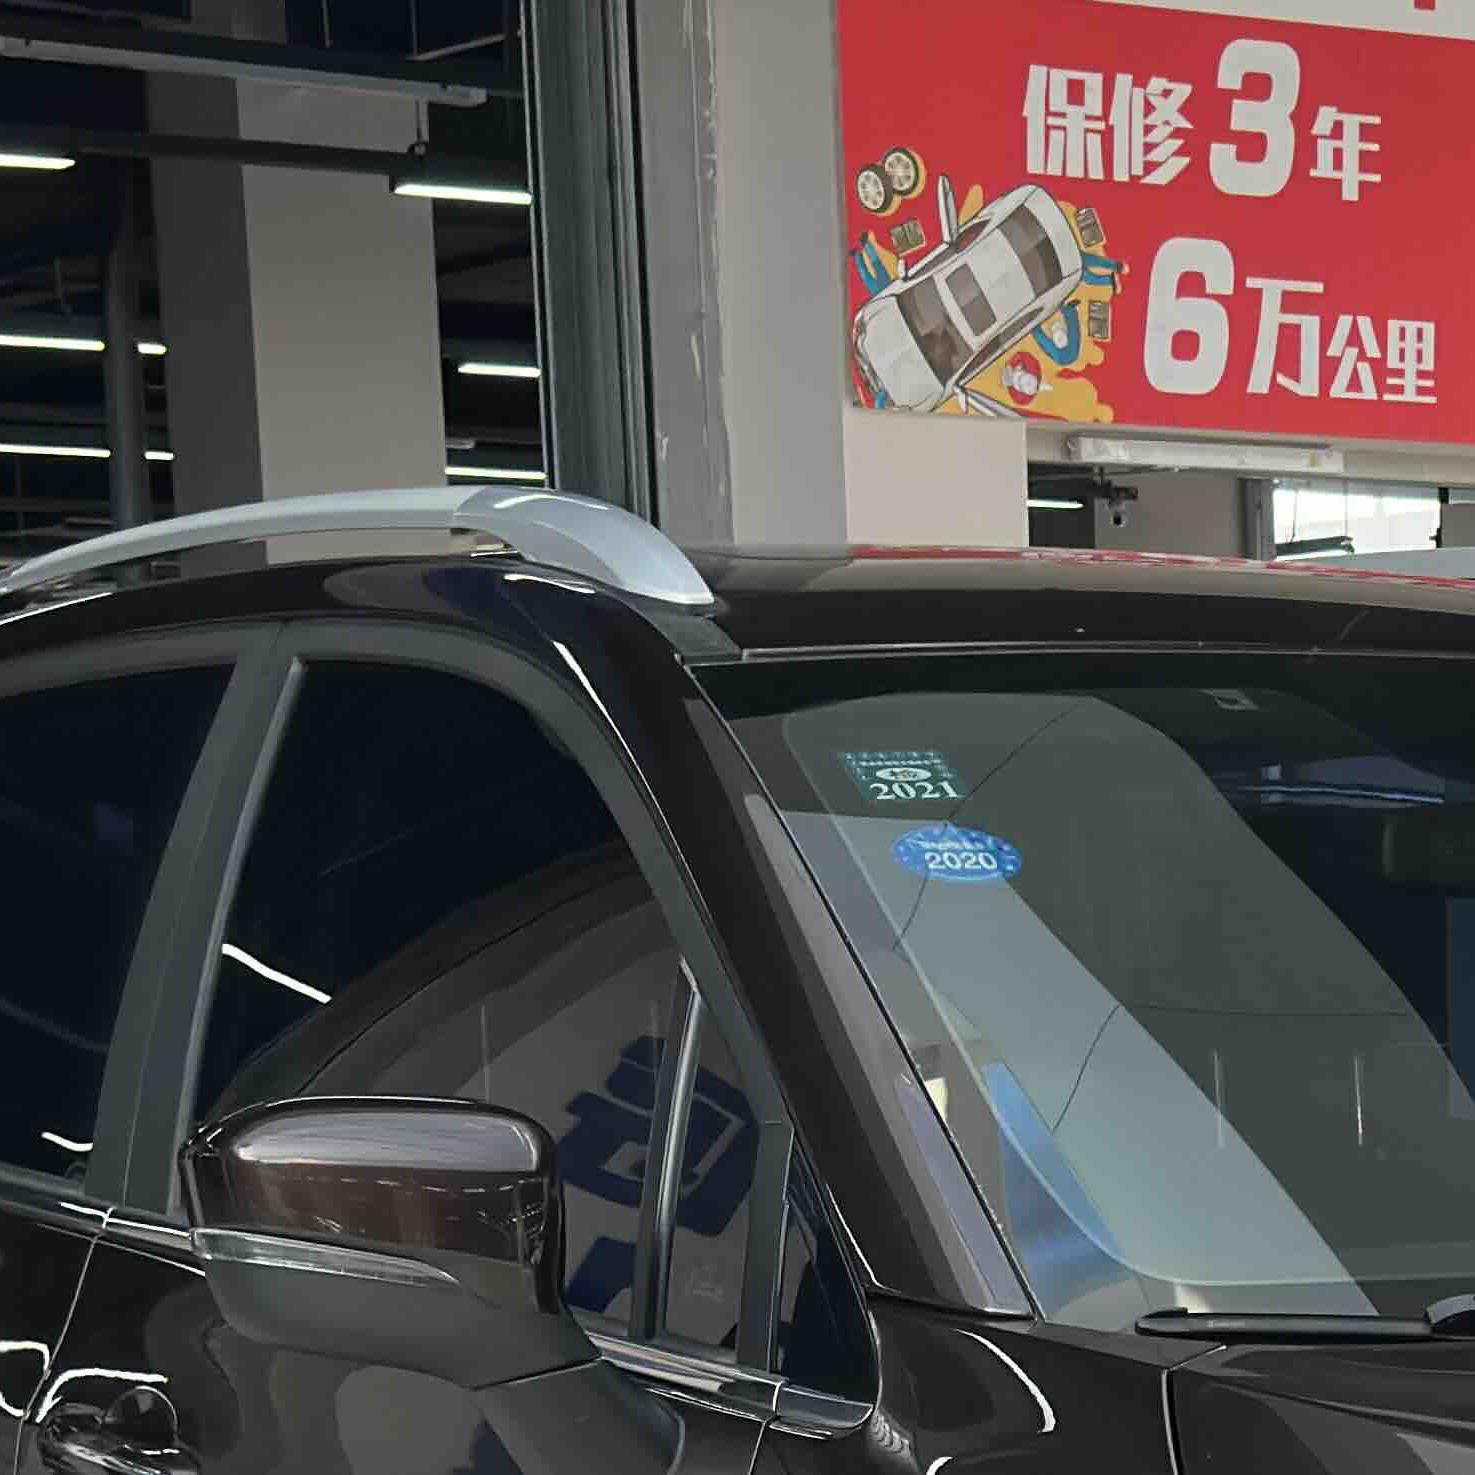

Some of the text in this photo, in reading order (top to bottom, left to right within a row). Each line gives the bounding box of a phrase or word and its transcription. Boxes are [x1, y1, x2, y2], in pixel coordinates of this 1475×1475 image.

[1022, 38, 1383, 202] 保修3年
[1143, 236, 1438, 404] 6万公里
[869, 781, 961, 800] 2021
[924, 851, 998, 871] 2020
